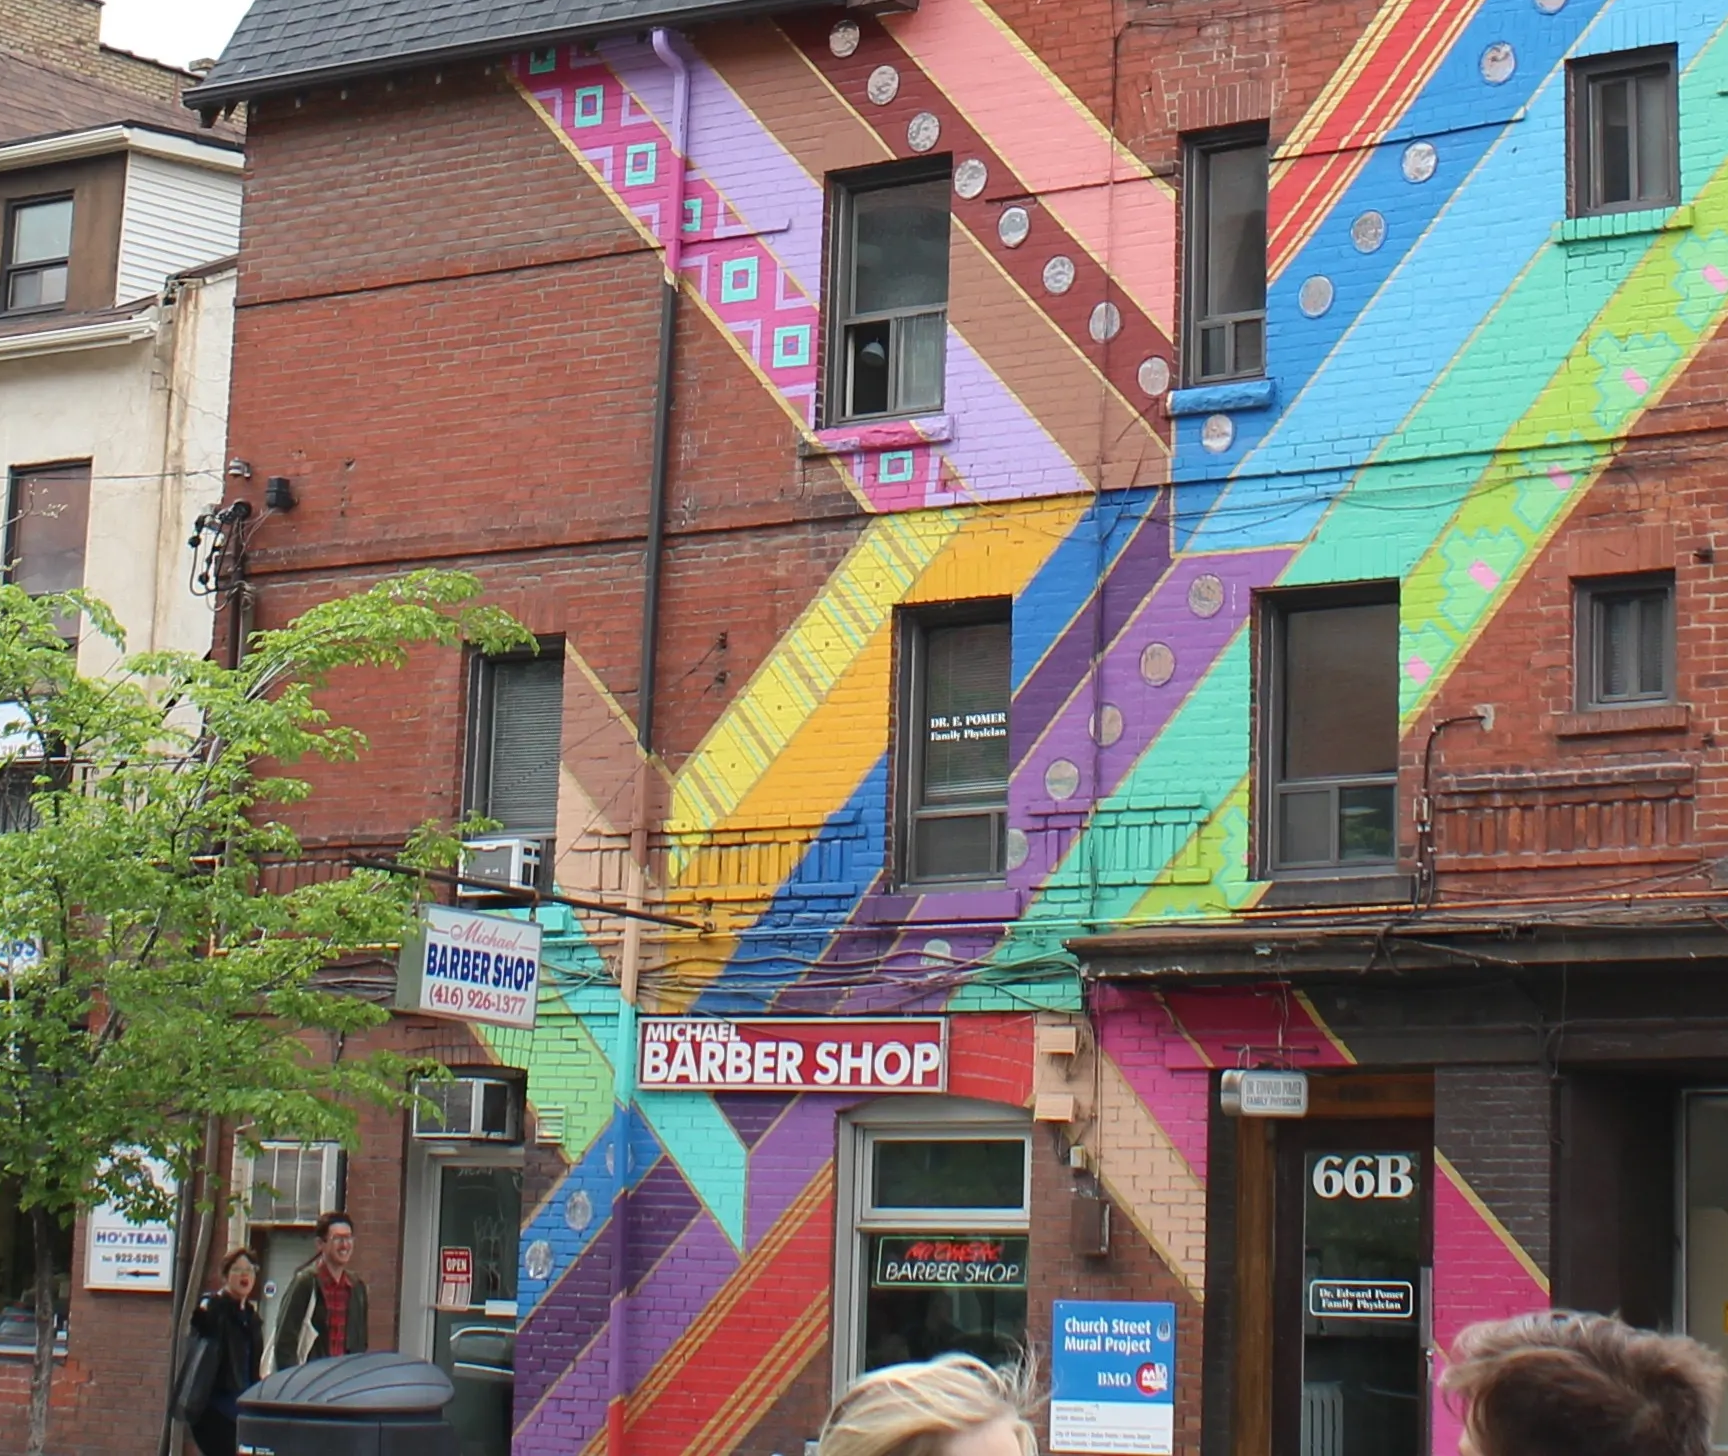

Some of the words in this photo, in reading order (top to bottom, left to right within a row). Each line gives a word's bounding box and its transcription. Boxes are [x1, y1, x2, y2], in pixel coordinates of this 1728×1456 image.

[930, 717, 950, 729] DR.
[965, 712, 1007, 725] POMER
[930, 731, 961, 742] Family
[963, 728, 1007, 740] Physician
[450, 919, 522, 951] Michael
[426, 942, 491, 986] BARBER
[492, 953, 536, 991] SHOP
[429, 983, 464, 1011] (416)
[467, 989, 527, 1015] 926-1377
[645, 1023, 741, 1042] MICHAEL
[642, 1042, 804, 1084] BARBER
[812, 1041, 941, 1086] SHOP
[1313, 1155, 1413, 1198] 66B
[446, 1257, 467, 1272] OPEN
[885, 1262, 960, 1281] BARBER
[964, 1263, 1019, 1282] SHOP
[1319, 1288, 1334, 1298] Dr.
[1336, 1288, 1372, 1299] Edward
[1375, 1289, 1404, 1300] Pomer
[1322, 1299, 1353, 1311] Family
[1356, 1299, 1402, 1311] Physician
[1065, 1316, 1108, 1334] Church
[1112, 1318, 1151, 1335] Street
[1065, 1335, 1101, 1352] Mural
[1105, 1337, 1151, 1356] Project
[1097, 1371, 1131, 1387] BMO
